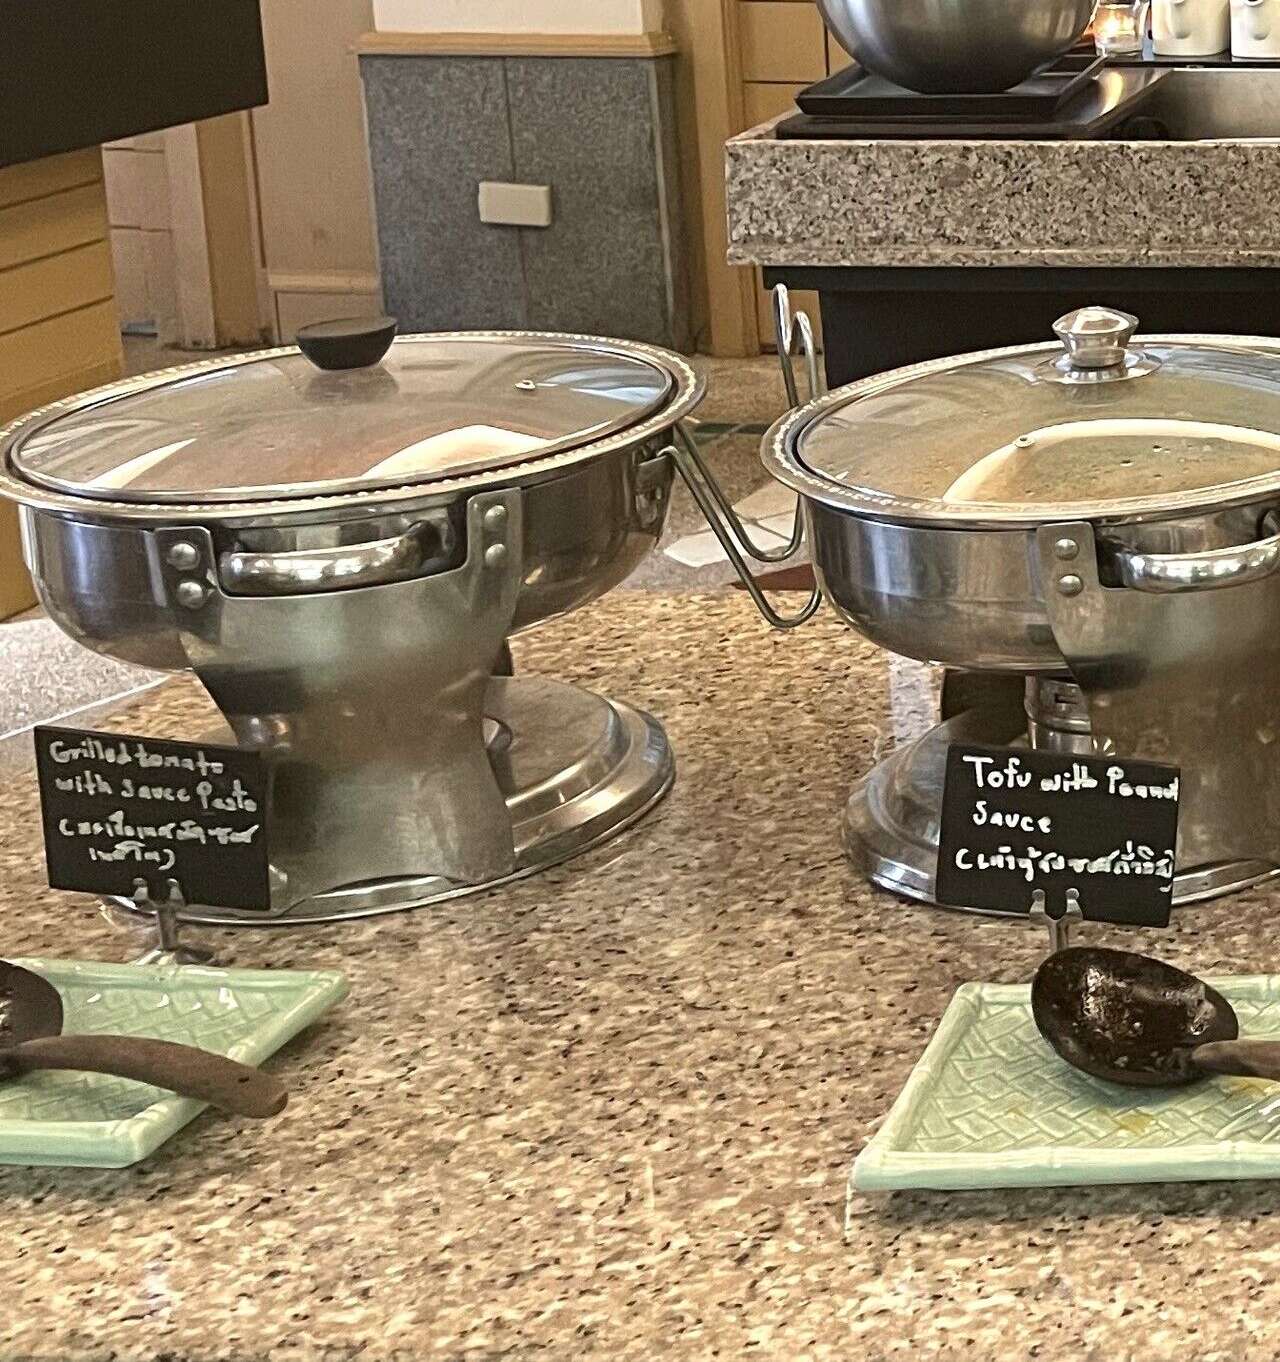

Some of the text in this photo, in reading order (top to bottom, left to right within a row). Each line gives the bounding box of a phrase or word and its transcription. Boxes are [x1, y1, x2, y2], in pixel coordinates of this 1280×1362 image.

[49, 736, 224, 777] Grilled tomato
[962, 755, 1032, 789] Tofu
[1039, 762, 1099, 793] with
[54, 769, 113, 797] with
[972, 800, 1052, 834] Sauce
